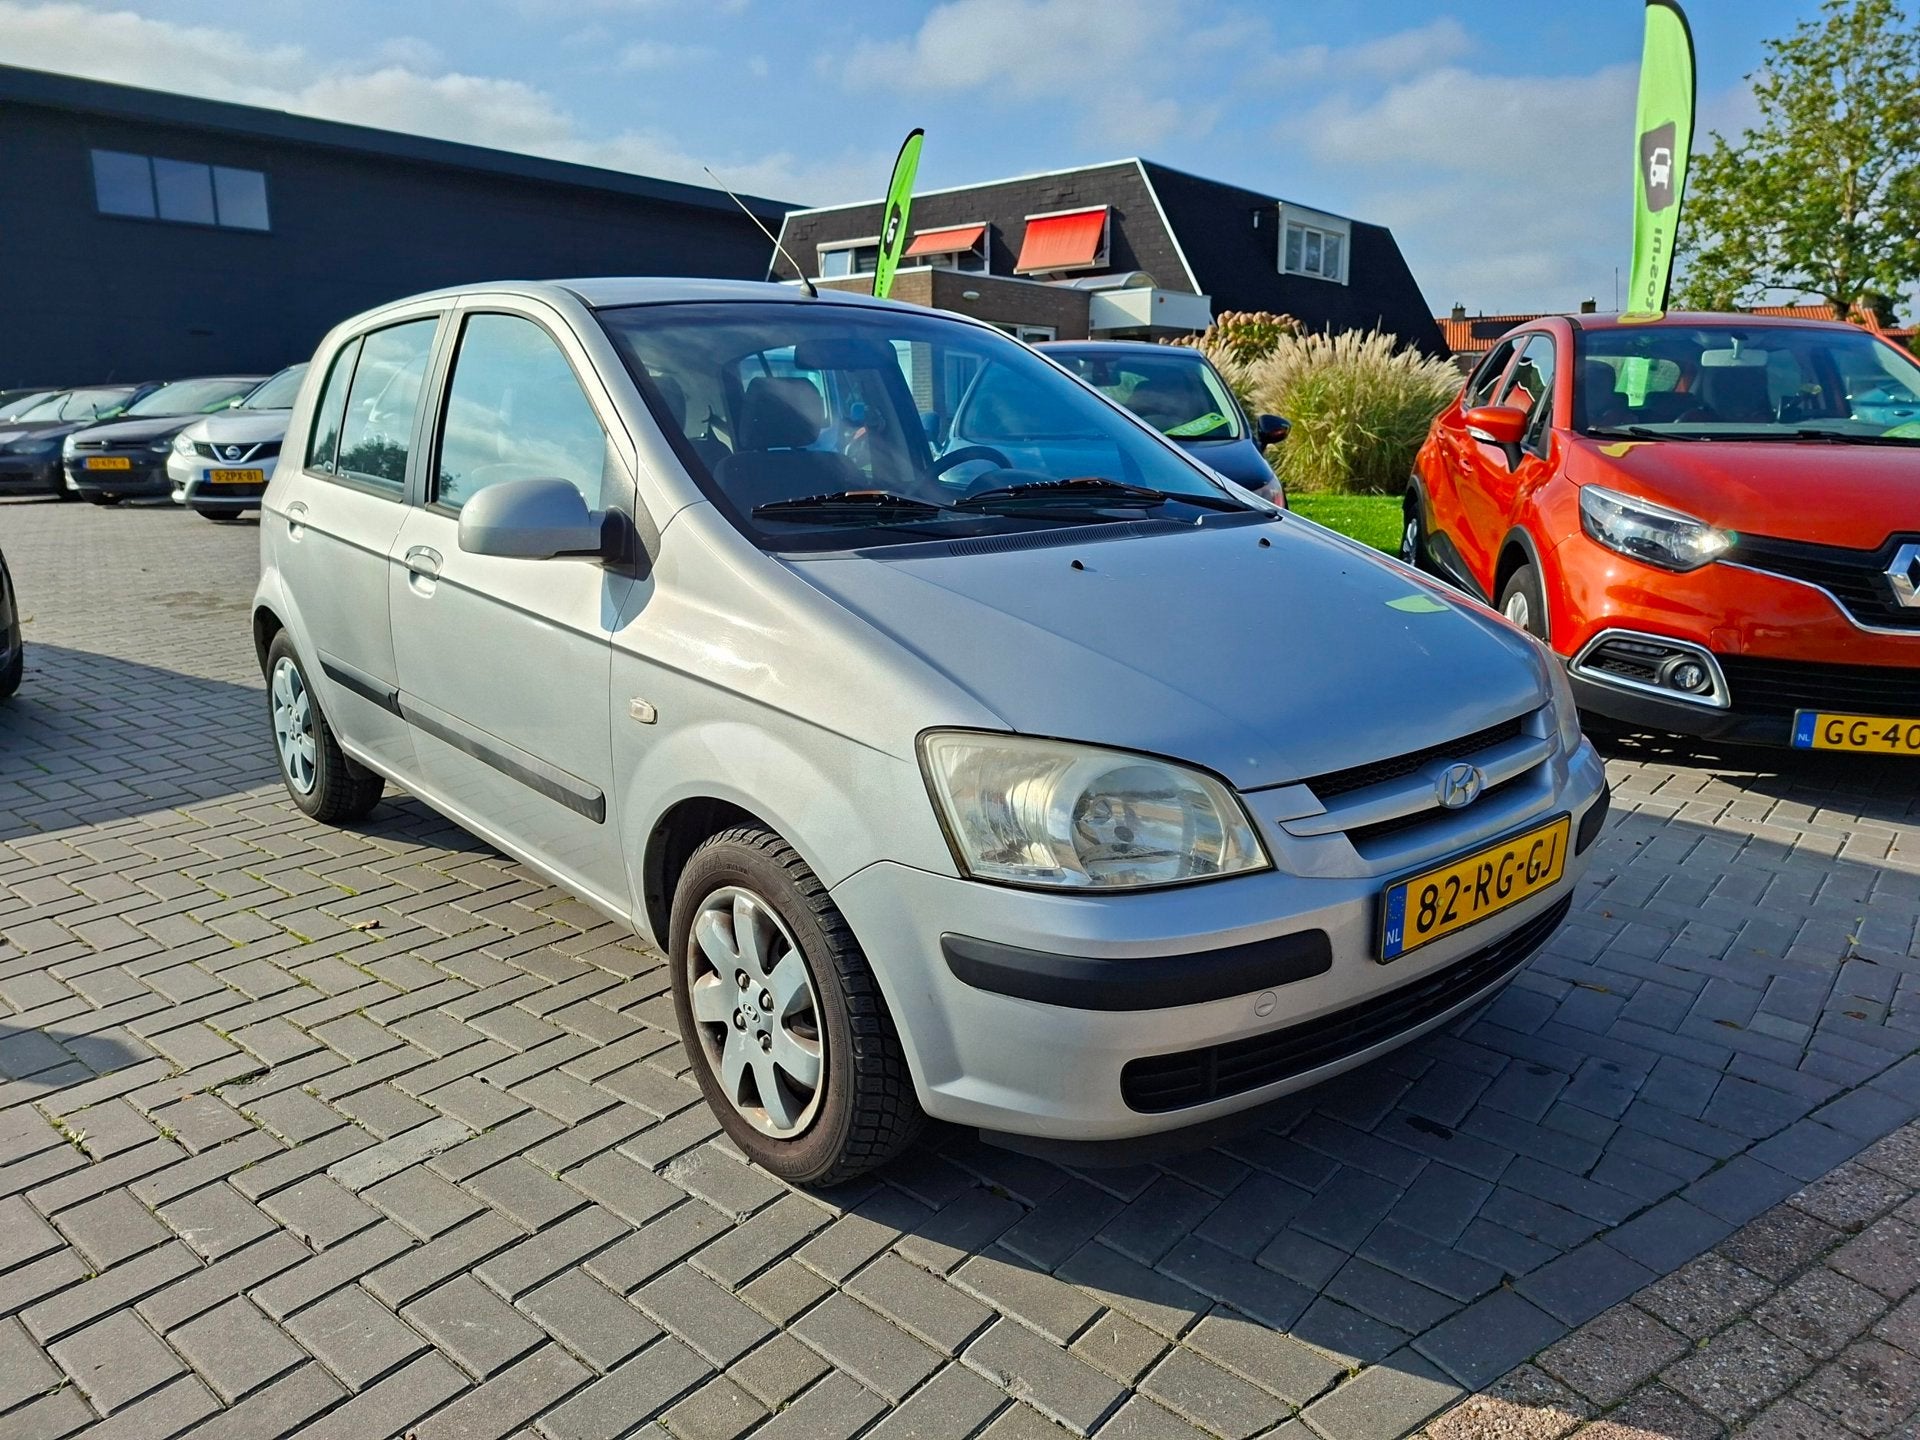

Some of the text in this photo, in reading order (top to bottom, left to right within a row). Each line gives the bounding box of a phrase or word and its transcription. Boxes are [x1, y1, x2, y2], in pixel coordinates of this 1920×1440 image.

[215, 471, 258, 482] 5-ZPX-81
[1797, 733, 1811, 742] NL
[1386, 833, 1558, 945] NL 82-RG-GJ
